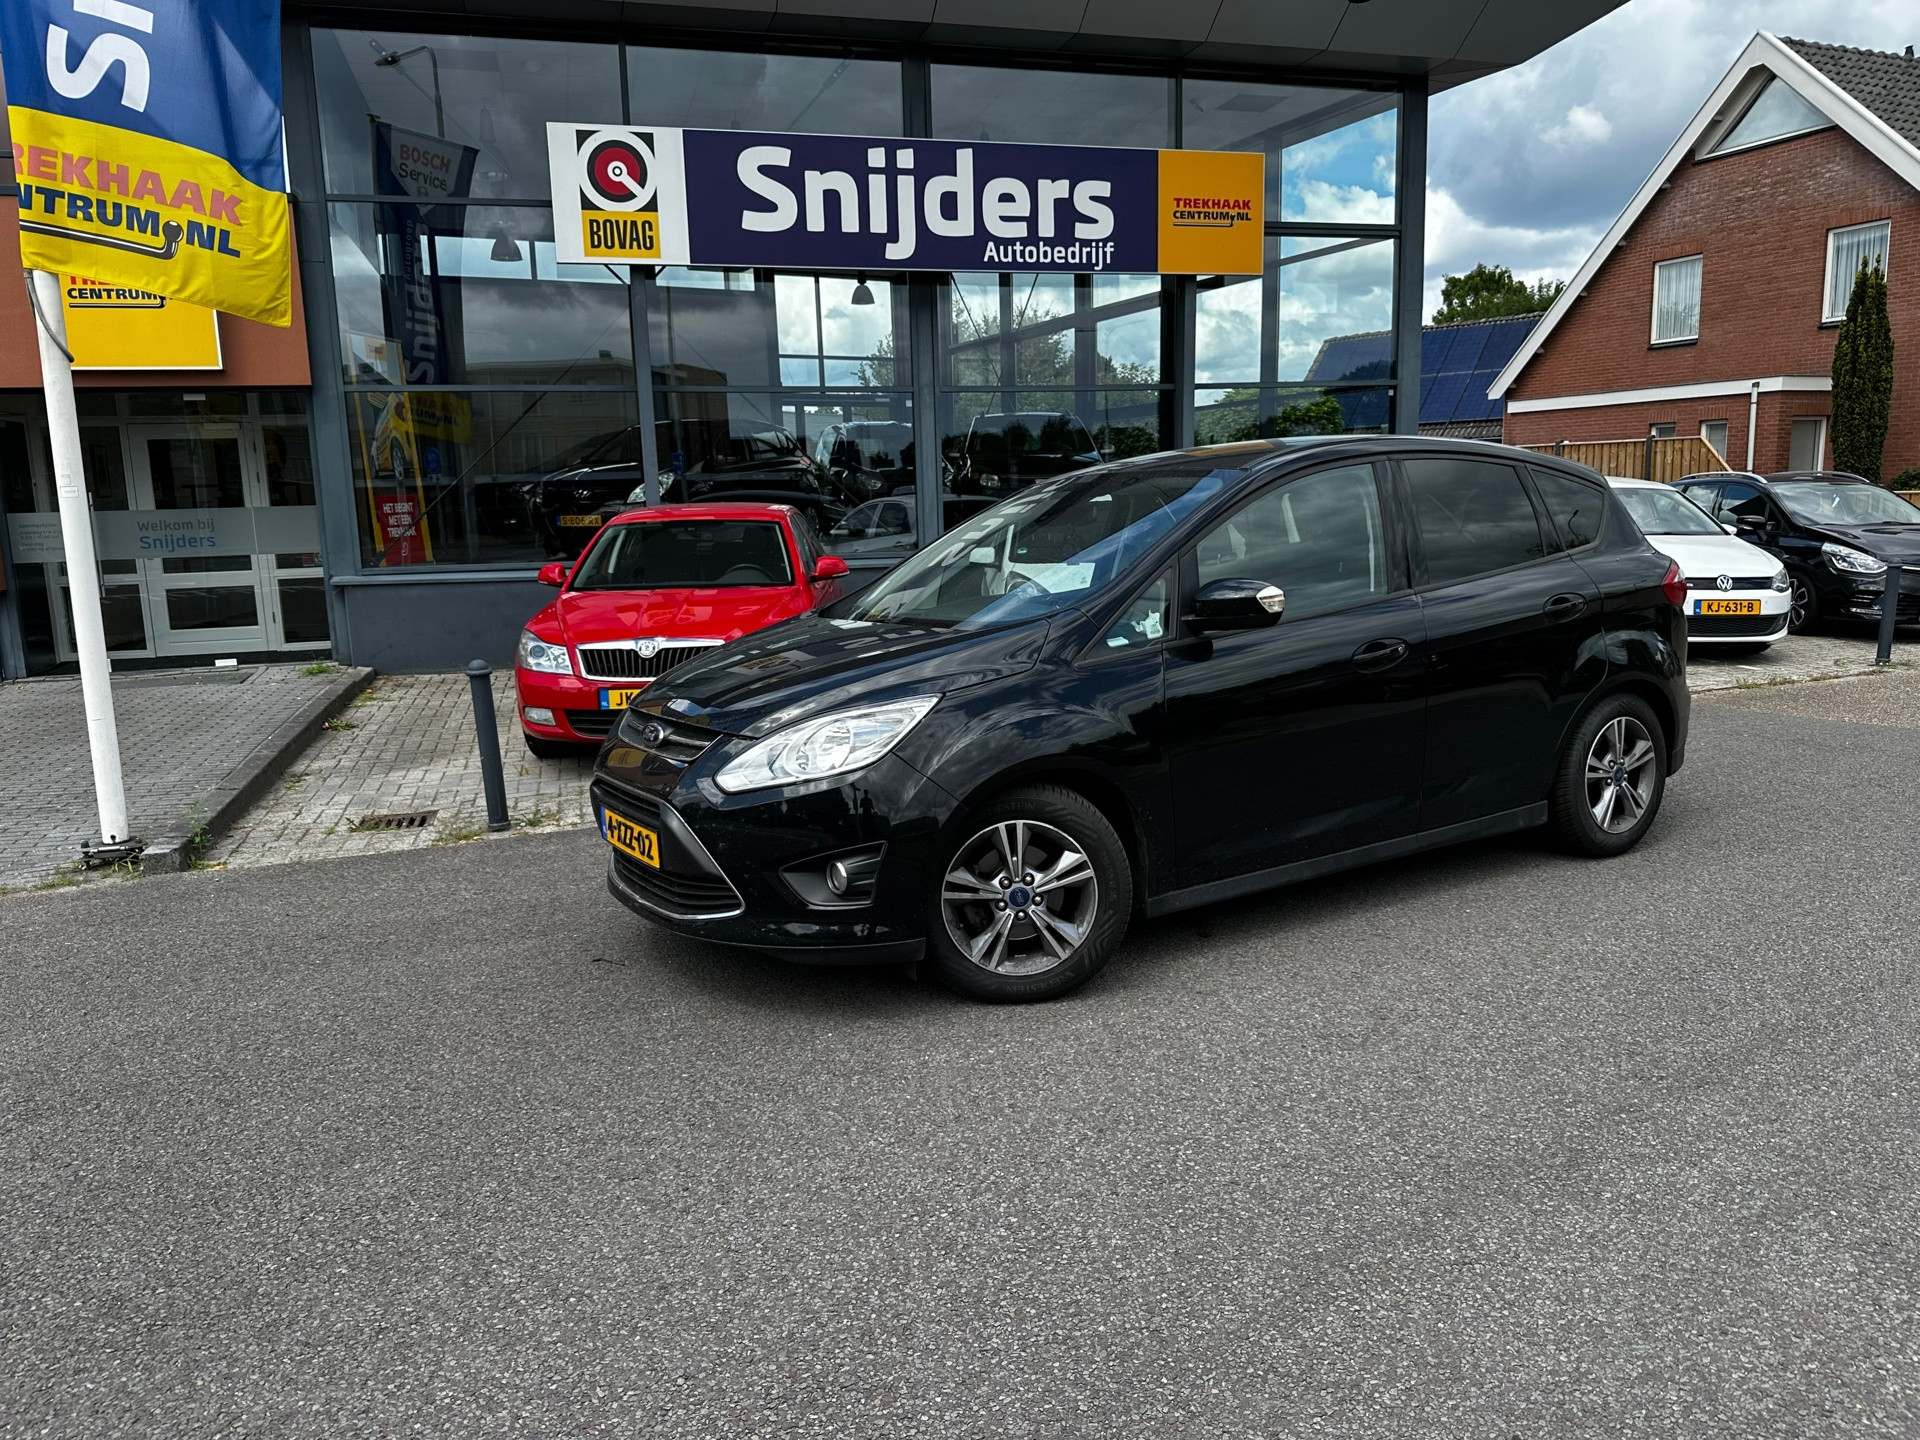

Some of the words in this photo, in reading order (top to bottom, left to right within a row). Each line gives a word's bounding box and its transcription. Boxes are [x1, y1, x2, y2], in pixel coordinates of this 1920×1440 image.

[399, 143, 452, 174] BOSCH
[398, 162, 448, 192] Service
[737, 145, 1115, 260] Snijders
[1173, 197, 1252, 210] TREKHAAK
[588, 217, 655, 251] BOVAG
[405, 219, 413, 283] Autogroep
[983, 241, 1115, 271] Autobedrijf
[383, 503, 394, 513] HET
[395, 502, 413, 513] BEGINT
[388, 515, 401, 525] MET
[401, 514, 412, 525] EEN
[137, 520, 193, 531] Welkom
[197, 518, 215, 532] bij
[139, 534, 216, 553] Snijders
[1707, 602, 1754, 613] KJ-631-B
